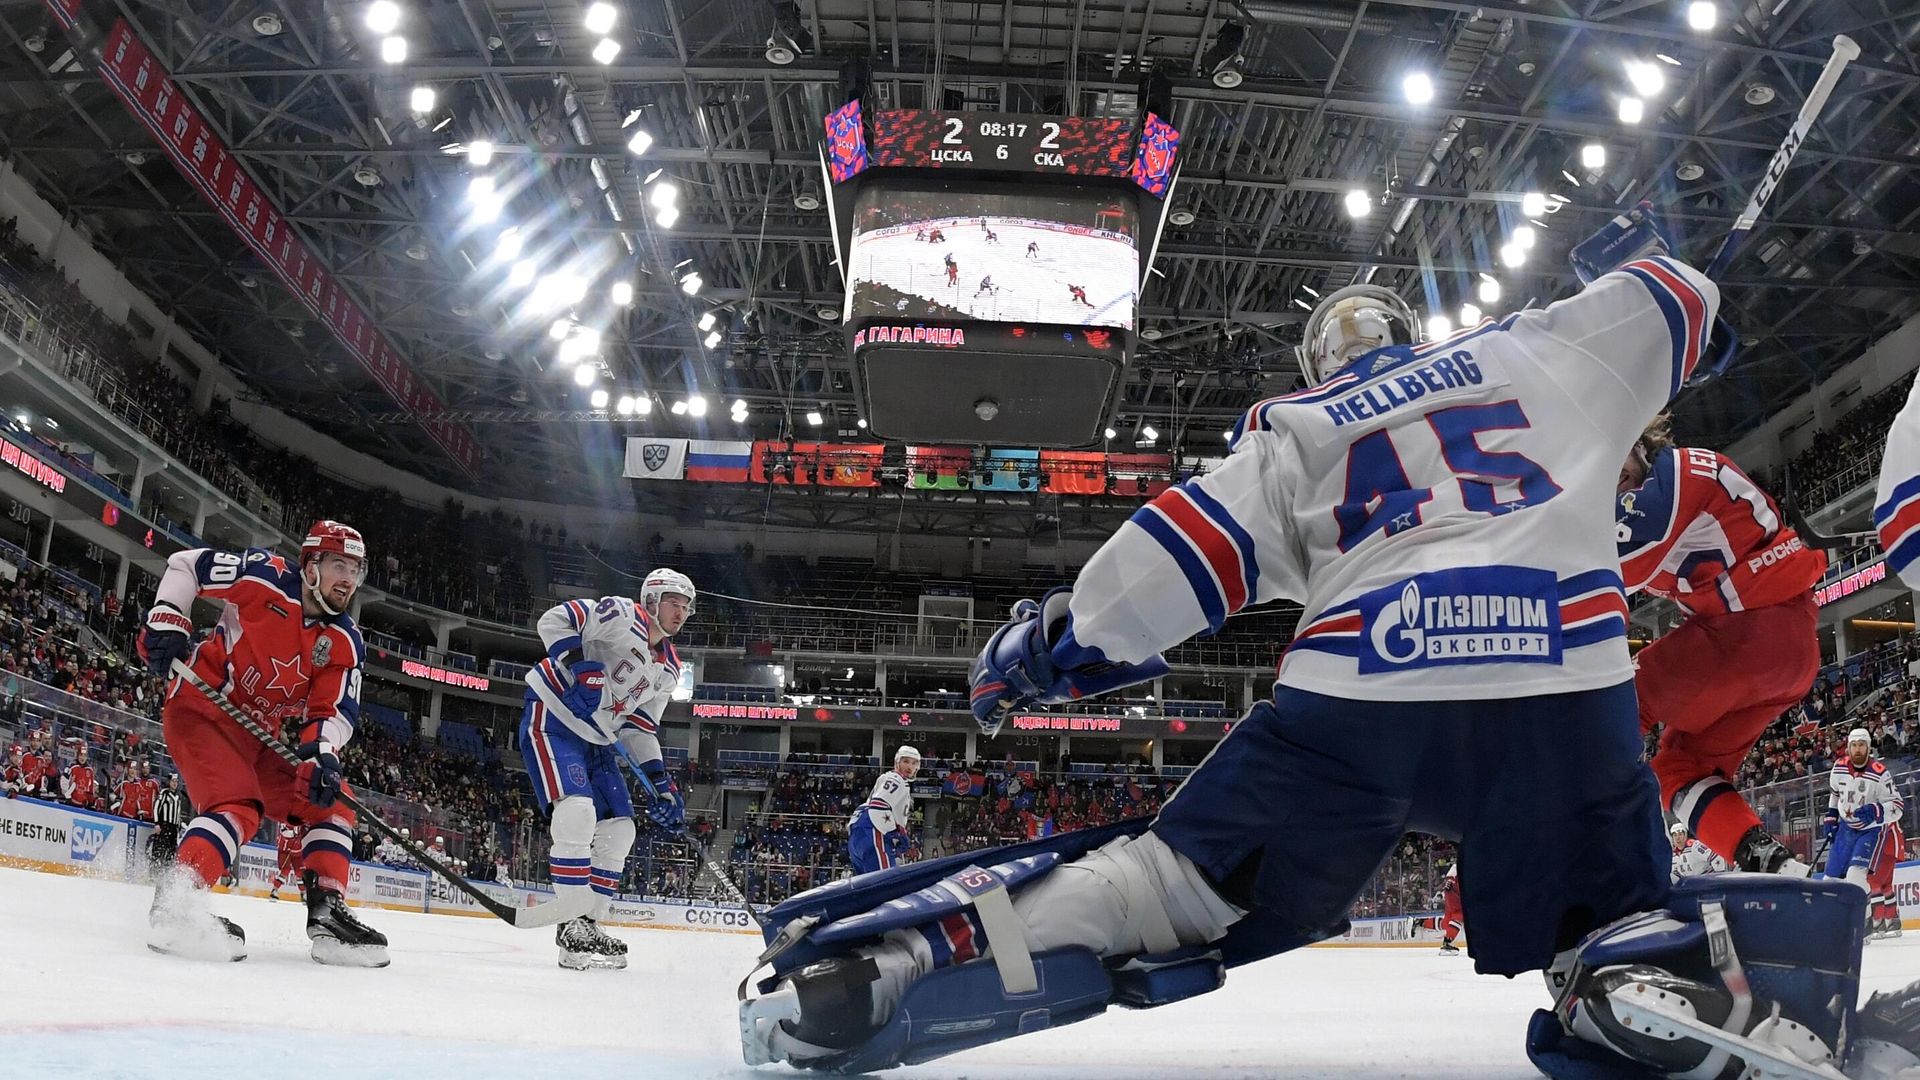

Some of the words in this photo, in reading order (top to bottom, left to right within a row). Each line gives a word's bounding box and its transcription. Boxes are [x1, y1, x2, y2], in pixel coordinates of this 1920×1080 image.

[943, 117, 964, 145] 2
[980, 121, 1028, 138] 08:17
[1040, 122, 1061, 149] 2
[931, 149, 974, 163] ЦСКА
[996, 144, 1009, 160] 6
[1034, 153, 1065, 167] СКА
[869, 325, 965, 345] ГАГАРИНА
[1324, 349, 1483, 427] HELLBERG
[19, 452, 67, 494] ШТУРМ!
[1333, 398, 1564, 555] 45
[8, 499, 31, 525] 310
[209, 552, 242, 582] 90
[150, 611, 193, 635] WARR
[595, 597, 620, 625] 91
[1423, 594, 1549, 630] ГАЗПРОМ
[1431, 637, 1545, 655] ЭКСПОРТ
[692, 703, 730, 718] ИДЕМ
[747, 705, 798, 720] ШТУРМ!
[1012, 715, 1050, 729] ИДЕМ
[1050, 717, 1069, 729] НА
[1069, 717, 1121, 731] ШТУРМ!
[720, 725, 743, 735] 317
[904, 731, 926, 742] 318
[0, 817, 12, 835] HE
[15, 821, 43, 840] BEST
[45, 827, 67, 844] RUN
[72, 825, 104, 854] SAP
